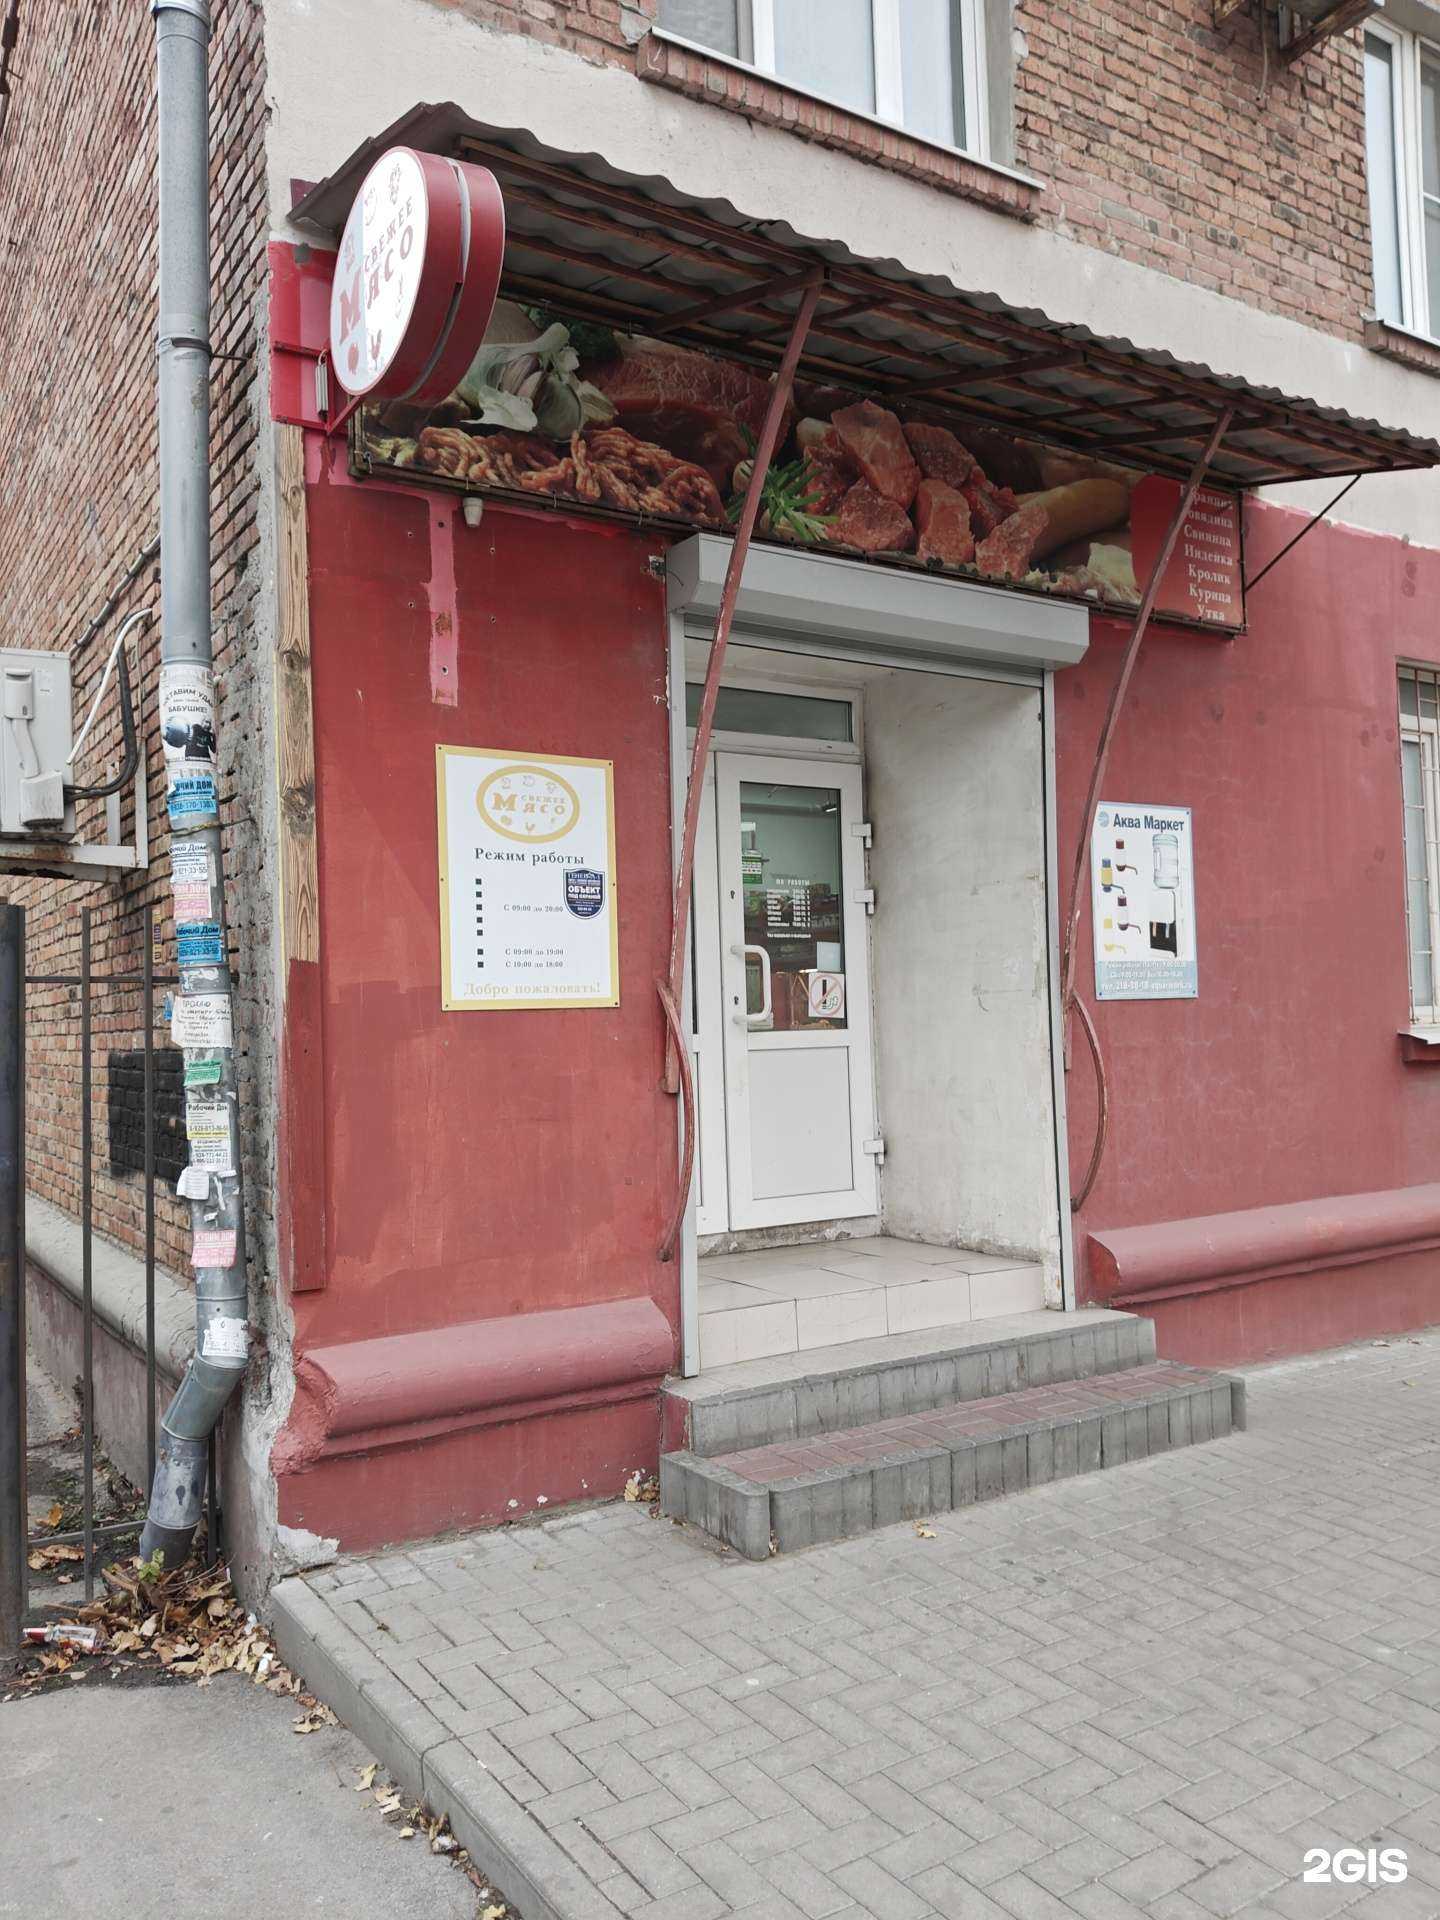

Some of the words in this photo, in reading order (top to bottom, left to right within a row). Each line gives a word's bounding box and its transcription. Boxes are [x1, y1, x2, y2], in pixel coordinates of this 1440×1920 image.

[363, 197, 413, 274] СВЕЖЕЕ
[1187, 508, 1233, 528] овядина
[1184, 524, 1231, 548] Свинина
[1185, 544, 1233, 566] Индейка
[1189, 563, 1231, 584] Кролик
[1189, 583, 1231, 604] Курица
[1197, 604, 1225, 621] Утка
[1113, 813, 1141, 829] Аква
[1144, 815, 1184, 833] Маркет
[475, 847, 525, 862] Режим
[532, 851, 584, 866] работы
[568, 885, 601, 894] ОБЪЕКТ
[200, 925, 219, 934] Дом
[464, 983, 509, 998] Добро
[514, 982, 601, 995] пожаловать!
[188, 1103, 215, 1111] Рабочий
